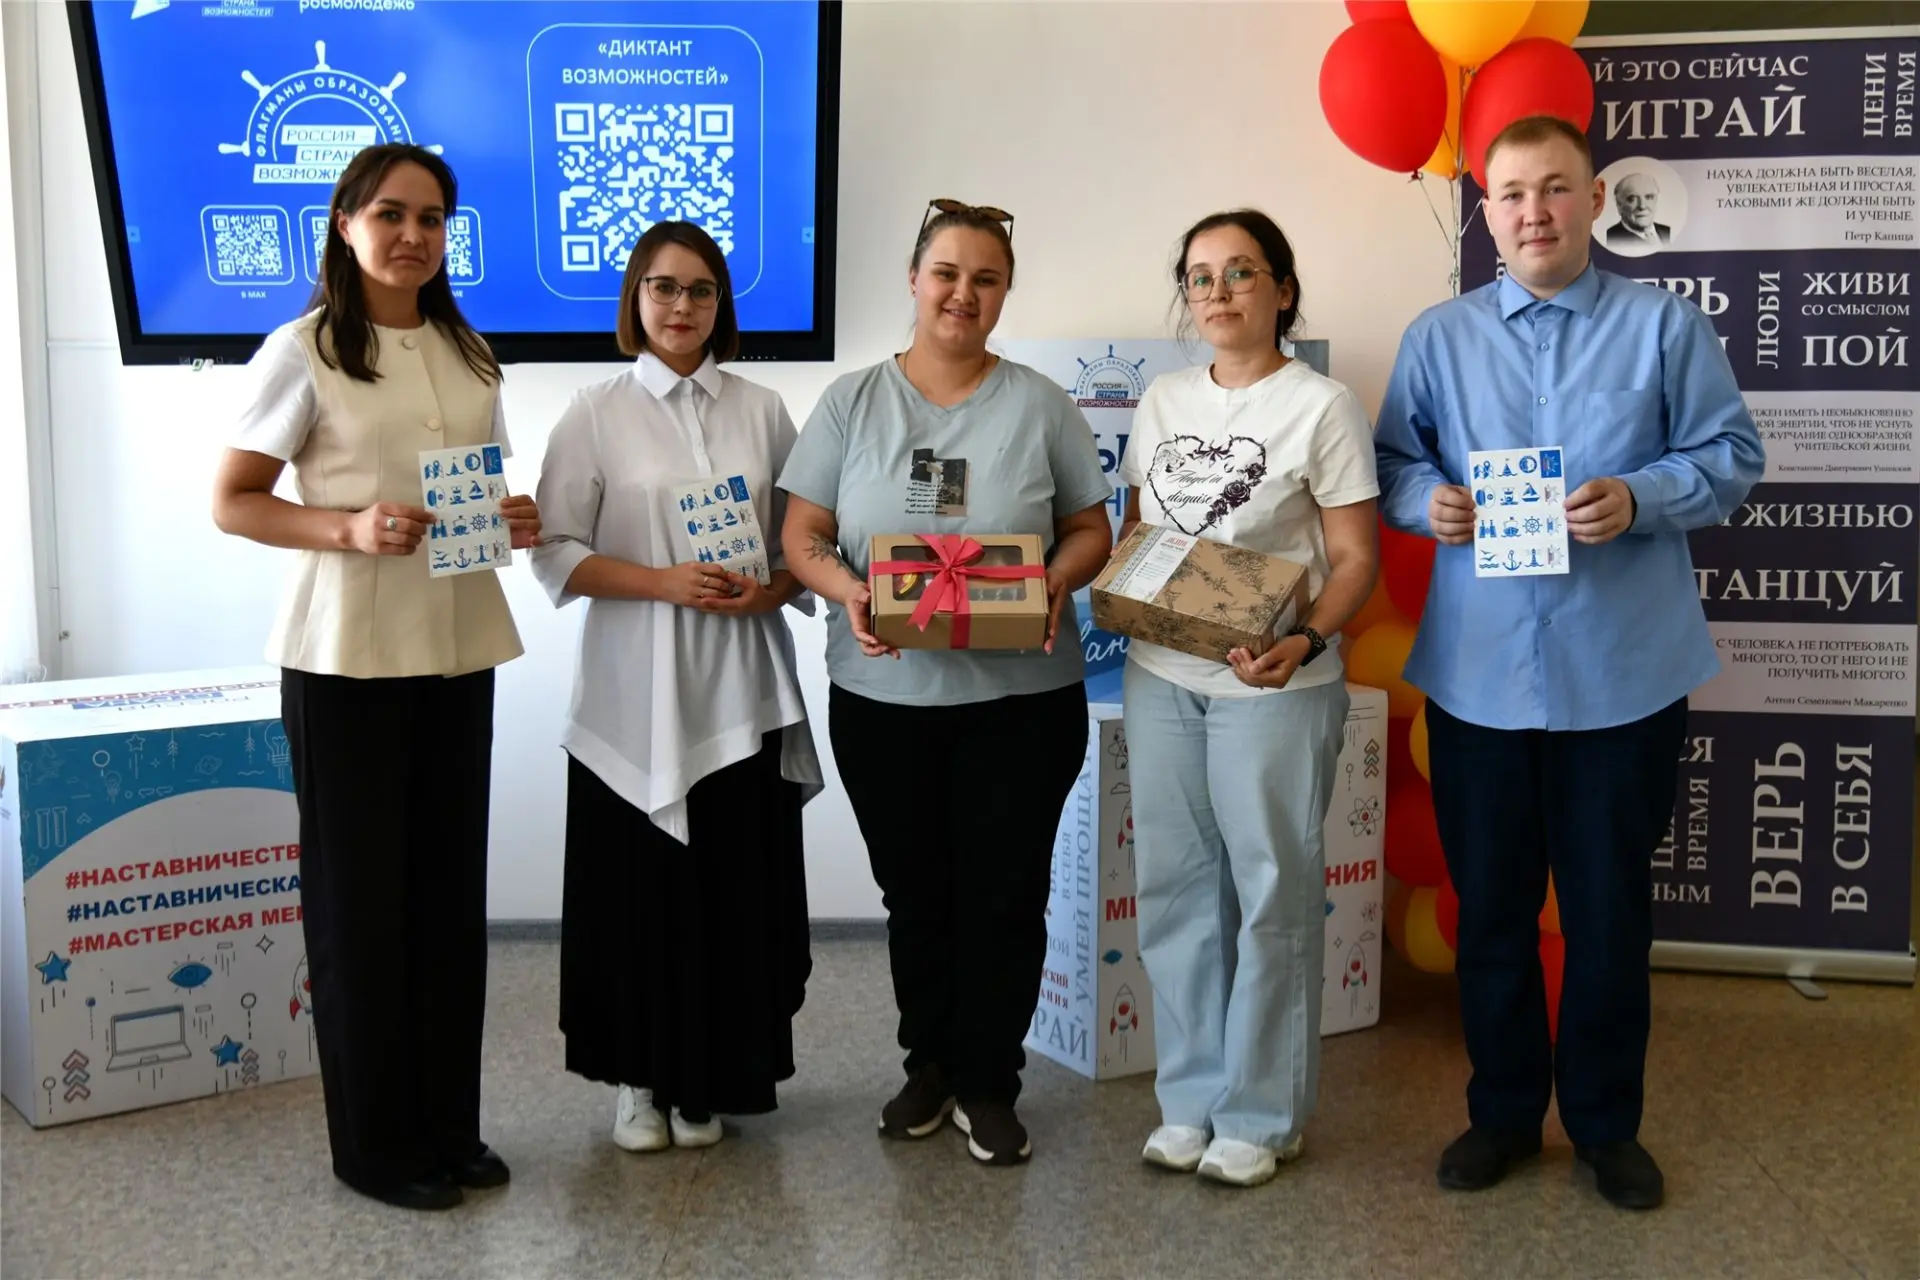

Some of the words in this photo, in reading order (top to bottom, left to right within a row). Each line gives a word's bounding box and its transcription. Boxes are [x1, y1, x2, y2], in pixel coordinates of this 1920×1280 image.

[204, 7, 272, 17] ВОЗМОЖНОСТЕЙ
[299, 0, 415, 14] росмолодежь
[598, 40, 692, 58] «ДИКТАНТ
[562, 67, 729, 85] ВОЗМОЖНОСТЕЙ»
[1621, 59, 1681, 82] ЭТО
[1688, 52, 1809, 80] СЕЙЧАС
[1863, 52, 1888, 138] ЦЕНИ
[1894, 51, 1917, 137] ВРЕМЯ
[255, 79, 307, 157] ФЛАГМАНЫ
[314, 76, 404, 143] ОБРАЗОВАН
[1602, 84, 1807, 141] ИГРАЙ
[286, 128, 356, 142] РОССИЯ
[301, 149, 357, 162] СТРАН
[259, 166, 343, 180] ВОЗМОЖН
[1707, 168, 1753, 181] НАУКА
[1755, 168, 1817, 180] ДОЛЖНА
[1819, 167, 1854, 178] БЫТЬ
[1726, 181, 1837, 194] УВЛЕКАТЕЛЬНАЯ
[1839, 181, 1850, 192] И
[1716, 197, 1792, 209] ТАКОВЫМИ
[1795, 197, 1816, 208] ЖЕ
[1817, 197, 1880, 209] ДОЛЖНЫ
[1882, 196, 1915, 207] БЫТЬ
[1845, 211, 1857, 221] И
[1844, 231, 1871, 243] Петр
[1874, 231, 1914, 242] Капица
[1802, 272, 1910, 296] ЖИВИ
[1801, 304, 1824, 316] СО
[1827, 304, 1910, 316] СМЫСЛОМ
[1757, 270, 1781, 369] ЛЮБИ
[1802, 327, 1909, 367] ПОЙ
[1784, 408, 1819, 417] ИМЕТЬ
[1858, 420, 1872, 428] НЕ
[1874, 420, 1913, 430] УСНУТЬ
[1794, 441, 1870, 452] УЧИТЕЛЬСКОЙ
[1166, 490, 1212, 509] disguise
[1742, 503, 1913, 529] ЖИЗНЬЮ
[1693, 562, 1904, 611] ТАНЦУЙ
[1716, 639, 1726, 649] С
[1728, 640, 1795, 650] ЧЕЛОВЕКА
[1798, 641, 1817, 650] НЕ
[1819, 641, 1909, 652] ПОТРЕБОВАТЬ
[1732, 653, 1798, 665] МНОГОГО,
[1801, 655, 1818, 665] ТО
[1820, 655, 1840, 665] ОТ
[1841, 656, 1876, 666] НЕГО
[1878, 656, 1888, 666] И
[1891, 656, 1908, 666] НЕ
[1767, 668, 1840, 680] ПОЛУЧИТЬ
[1841, 669, 1907, 680] МНОГОГО.
[1764, 696, 1795, 705] Антон
[1797, 696, 1852, 707] Семенович
[1853, 697, 1908, 709] Макаренко
[1832, 743, 1873, 870] СЕБЯ
[1687, 778, 1710, 870] ВРЕМЯ
[1750, 742, 1806, 908] ВЕРЬ
[65, 844, 302, 890] #НАСТАВНИЧЕСТВ
[67, 876, 300, 923] #НАСТАВНИЧЕСКА
[1831, 885, 1868, 913] В
[68, 912, 253, 955] #МАСТЕРСКАЯ
[1073, 906, 1093, 1008] УМЕЙ
